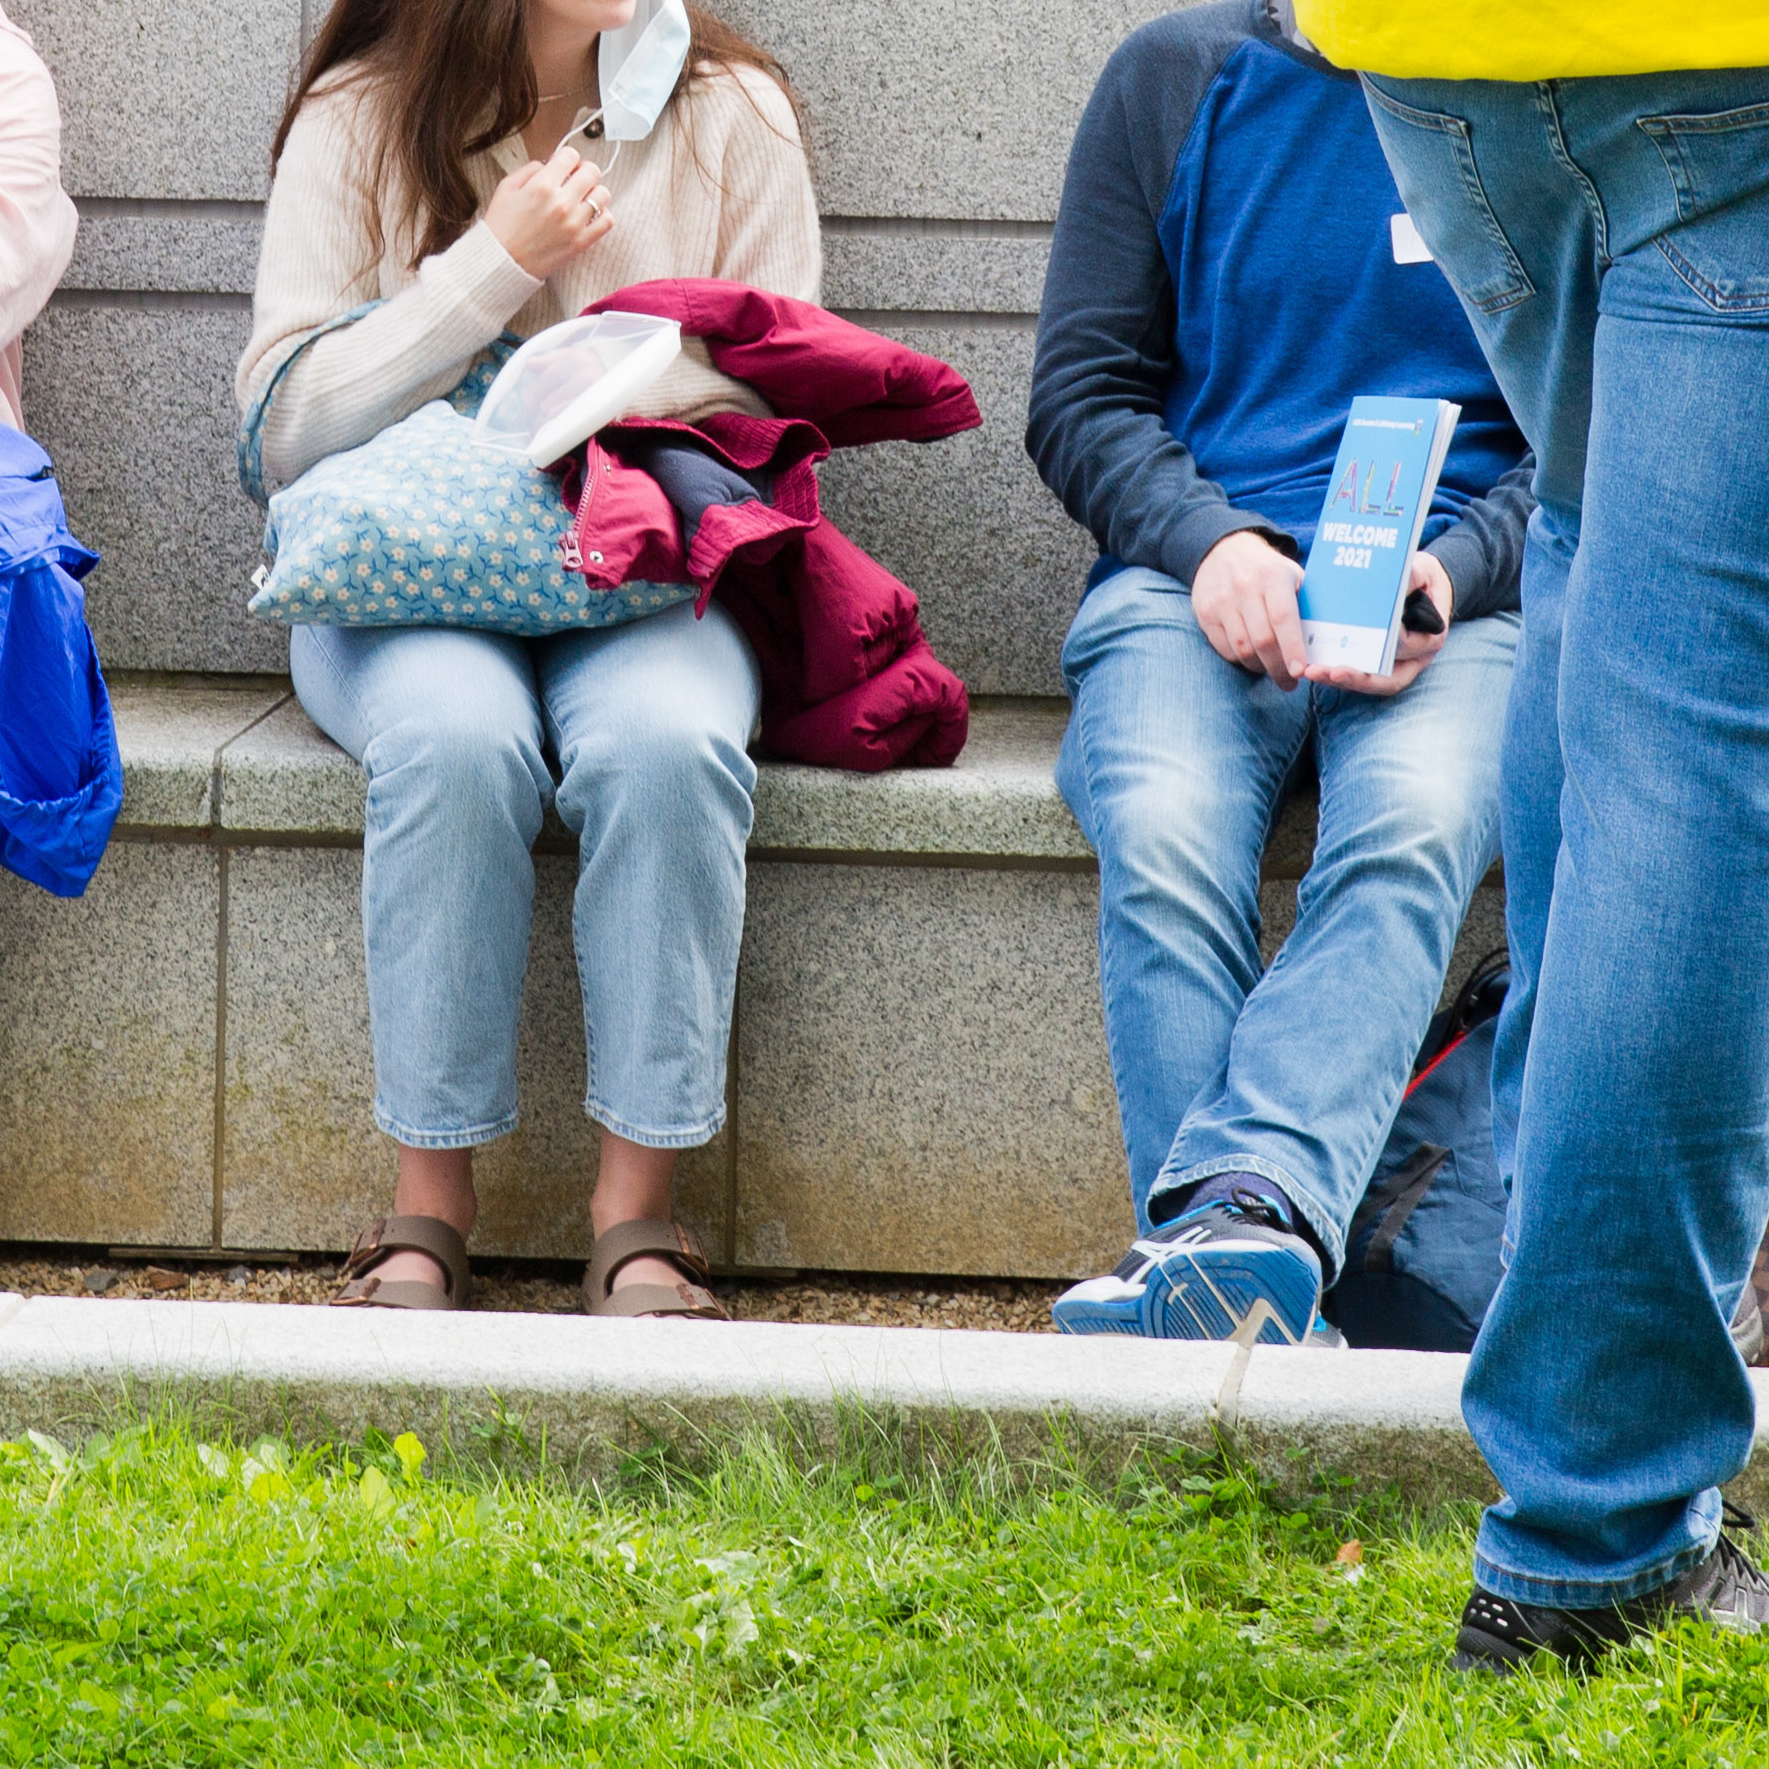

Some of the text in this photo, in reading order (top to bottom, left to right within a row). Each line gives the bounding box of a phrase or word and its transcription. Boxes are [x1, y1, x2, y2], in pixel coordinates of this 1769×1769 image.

[1329, 457, 1404, 517] ALL
[1322, 521, 1399, 549] WELCOME
[1333, 545, 1373, 569] 2021
